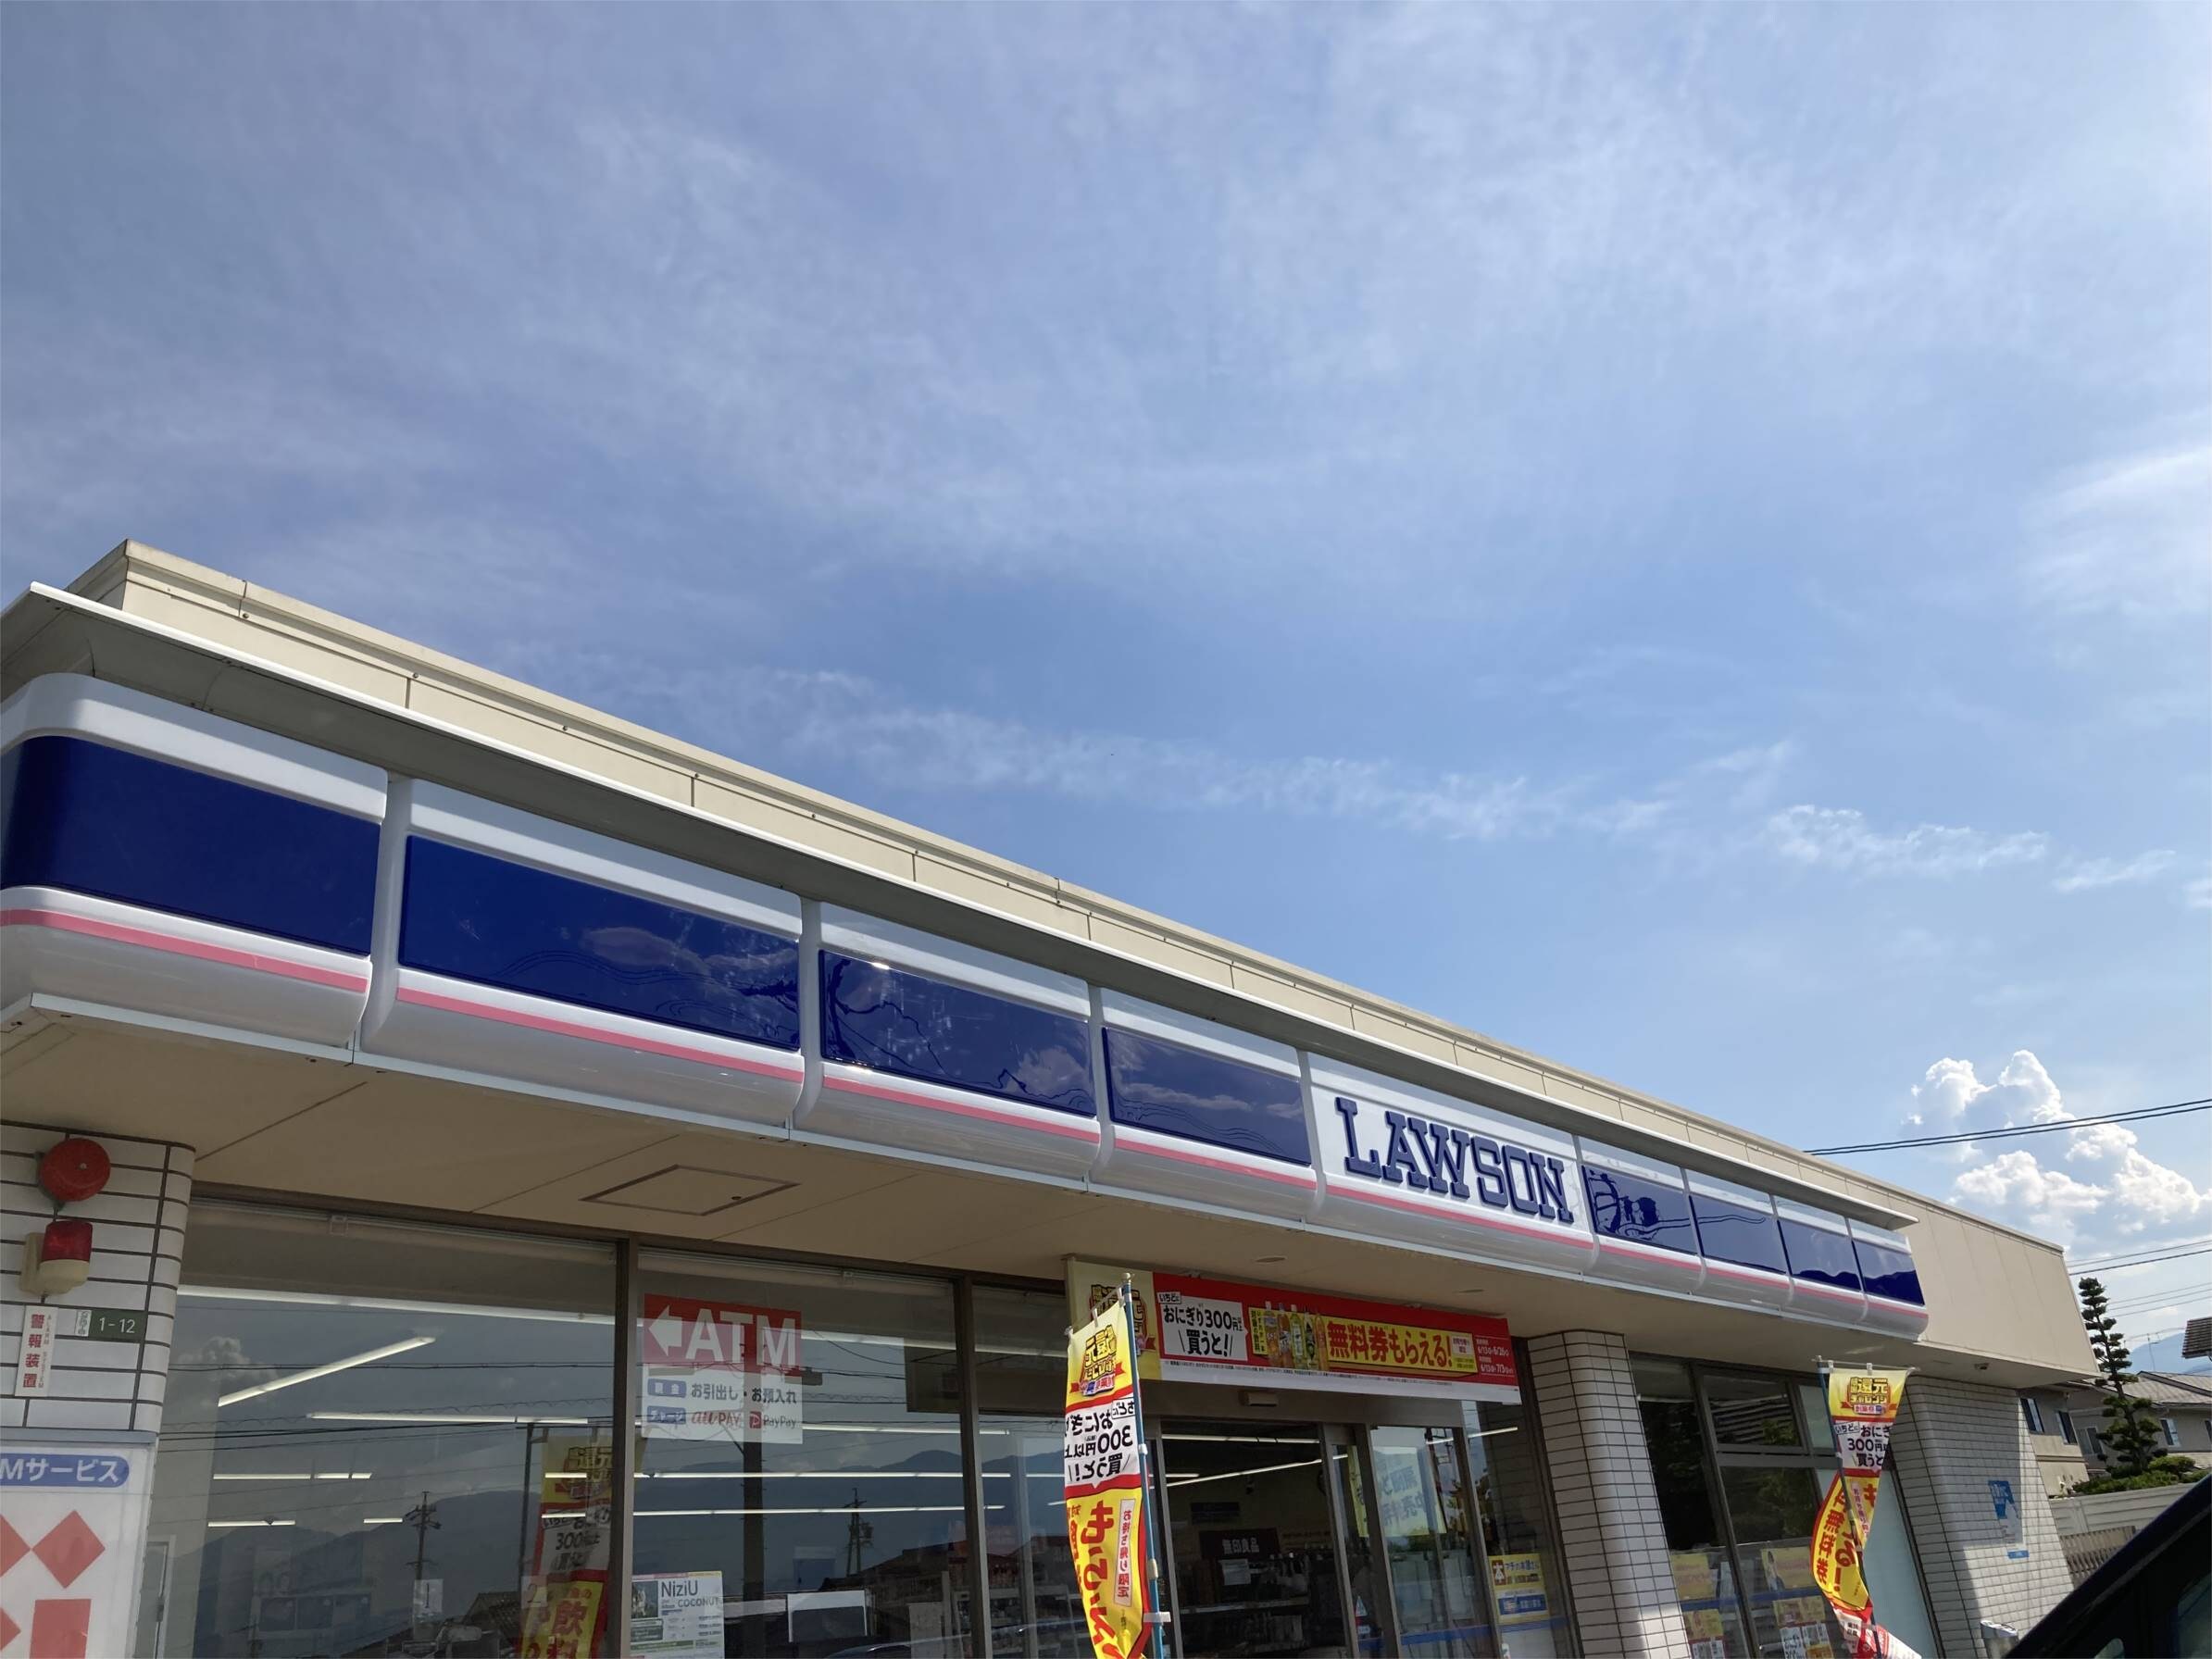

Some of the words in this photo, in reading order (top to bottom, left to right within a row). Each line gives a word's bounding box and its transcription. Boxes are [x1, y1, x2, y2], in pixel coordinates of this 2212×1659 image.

[1334, 1097, 1574, 1224] LAWSON
[99, 1317, 136, 1334] 1-12
[685, 1308, 796, 1367] ATM
[22, 1314, 45, 1388] 警報装置
[1327, 1322, 1453, 1367] 無料券もらえる!
[0, 1457, 119, 1483] Mサービス
[661, 1579, 698, 1598] NiziU
[678, 1597, 719, 1608] COCONUT
